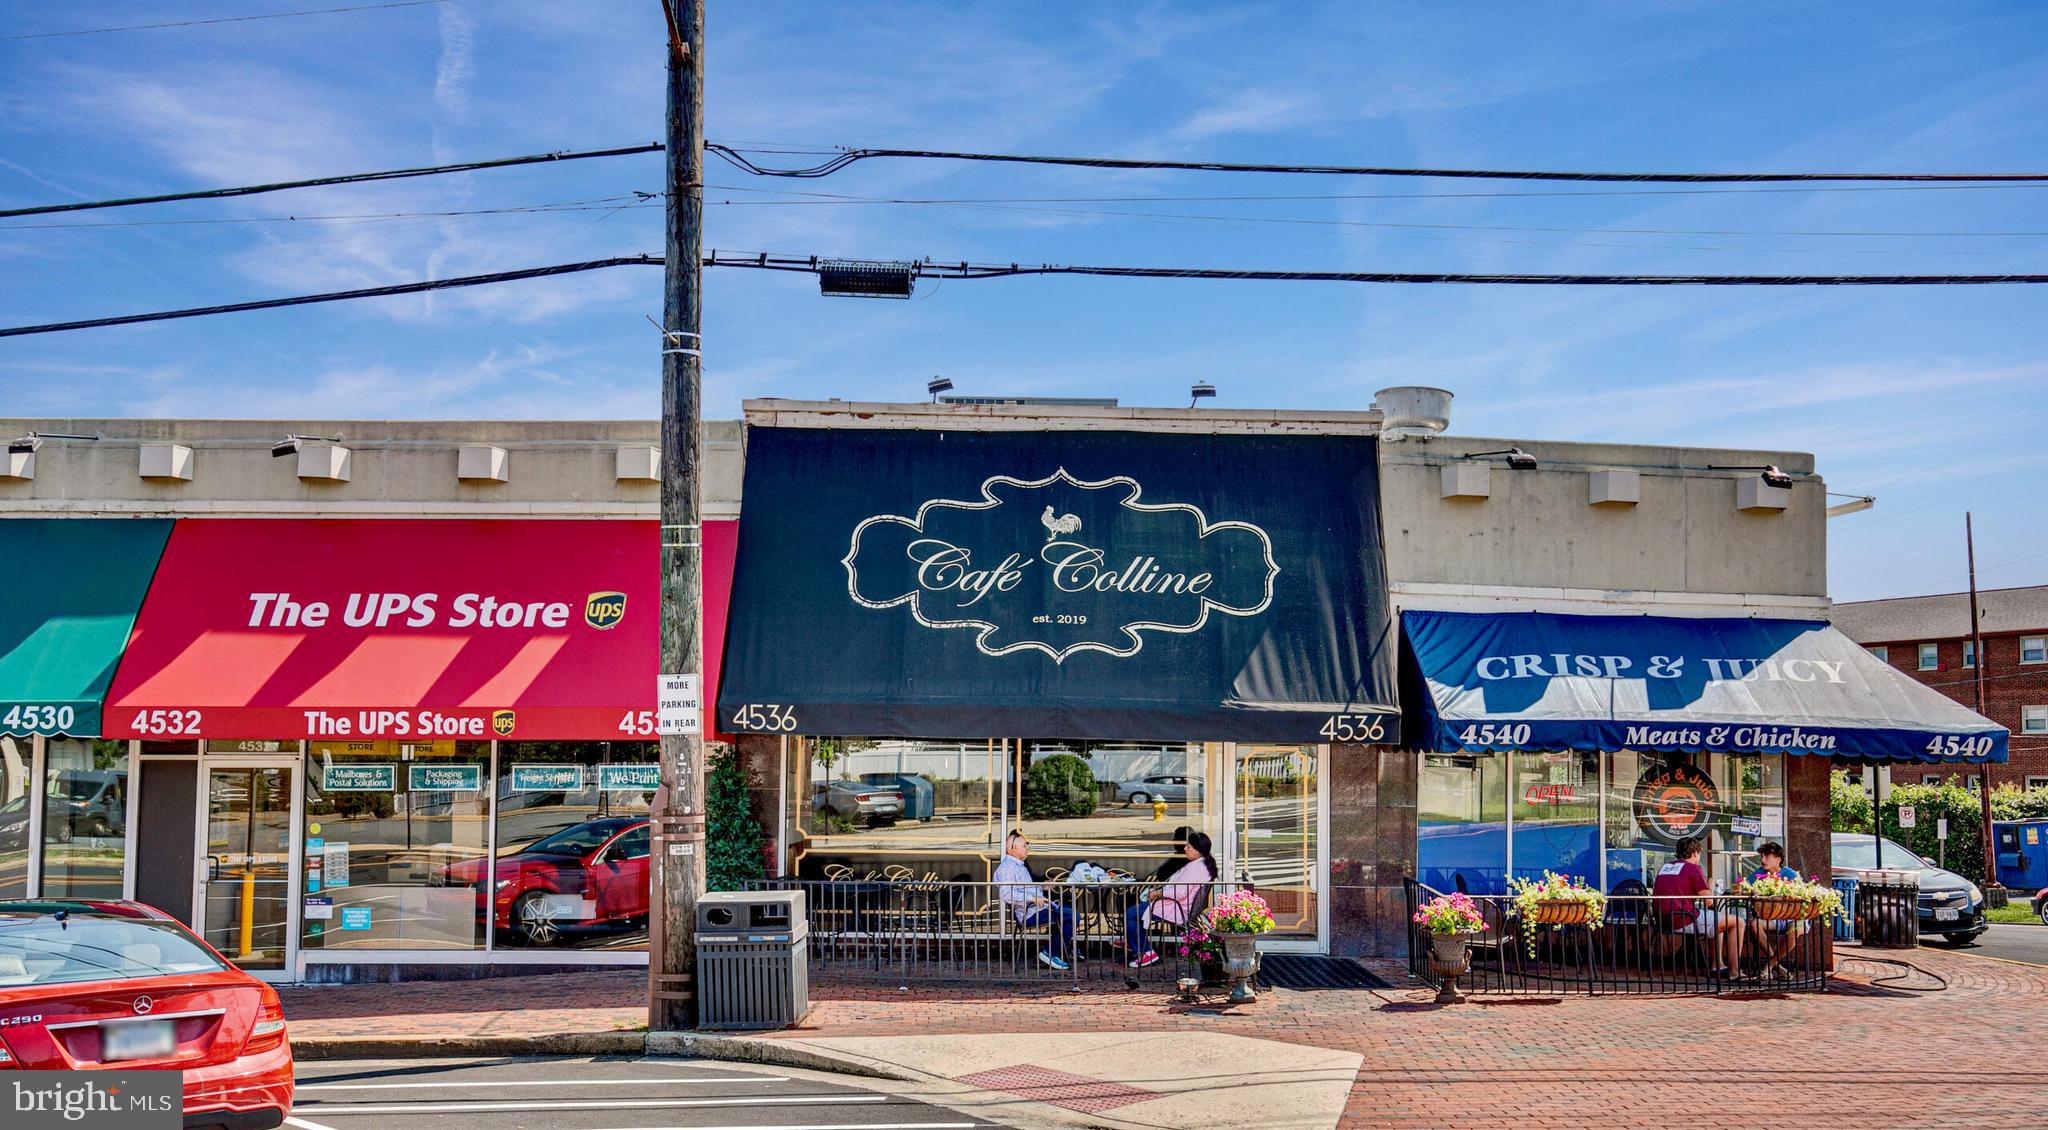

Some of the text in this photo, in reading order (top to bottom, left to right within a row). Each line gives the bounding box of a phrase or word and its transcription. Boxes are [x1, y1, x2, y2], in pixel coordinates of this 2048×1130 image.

[907, 539, 1213, 607] Café Colline
[248, 593, 329, 627] The
[343, 593, 438, 627] UPS
[448, 593, 569, 627] Store
[1032, 614, 1087, 625] est. 2019
[1477, 653, 1847, 686] CRISP & JUICY
[666, 681, 689, 690] MORE
[661, 700, 696, 709] PARKING
[2, 705, 75, 730] 4530
[131, 709, 202, 734] 4532
[304, 711, 351, 735] The
[358, 711, 410, 735] UPS
[417, 711, 485, 735] Store
[675, 719, 696, 728] REAR
[732, 704, 797, 731] 4536
[1319, 715, 1384, 741] 4536
[1459, 724, 1531, 745] 4540
[1624, 726, 1836, 750] Meats & Chicken
[1926, 736, 1993, 757] 4540
[329, 778, 388, 787] Postal Solutions
[335, 769, 382, 778] Mailboxes &
[425, 777, 463, 788] & Shipping
[426, 769, 462, 779] Packaging
[610, 771, 658, 785] We Print
[1674, 768, 1686, 781] &
[1525, 783, 1575, 806] OPEN
